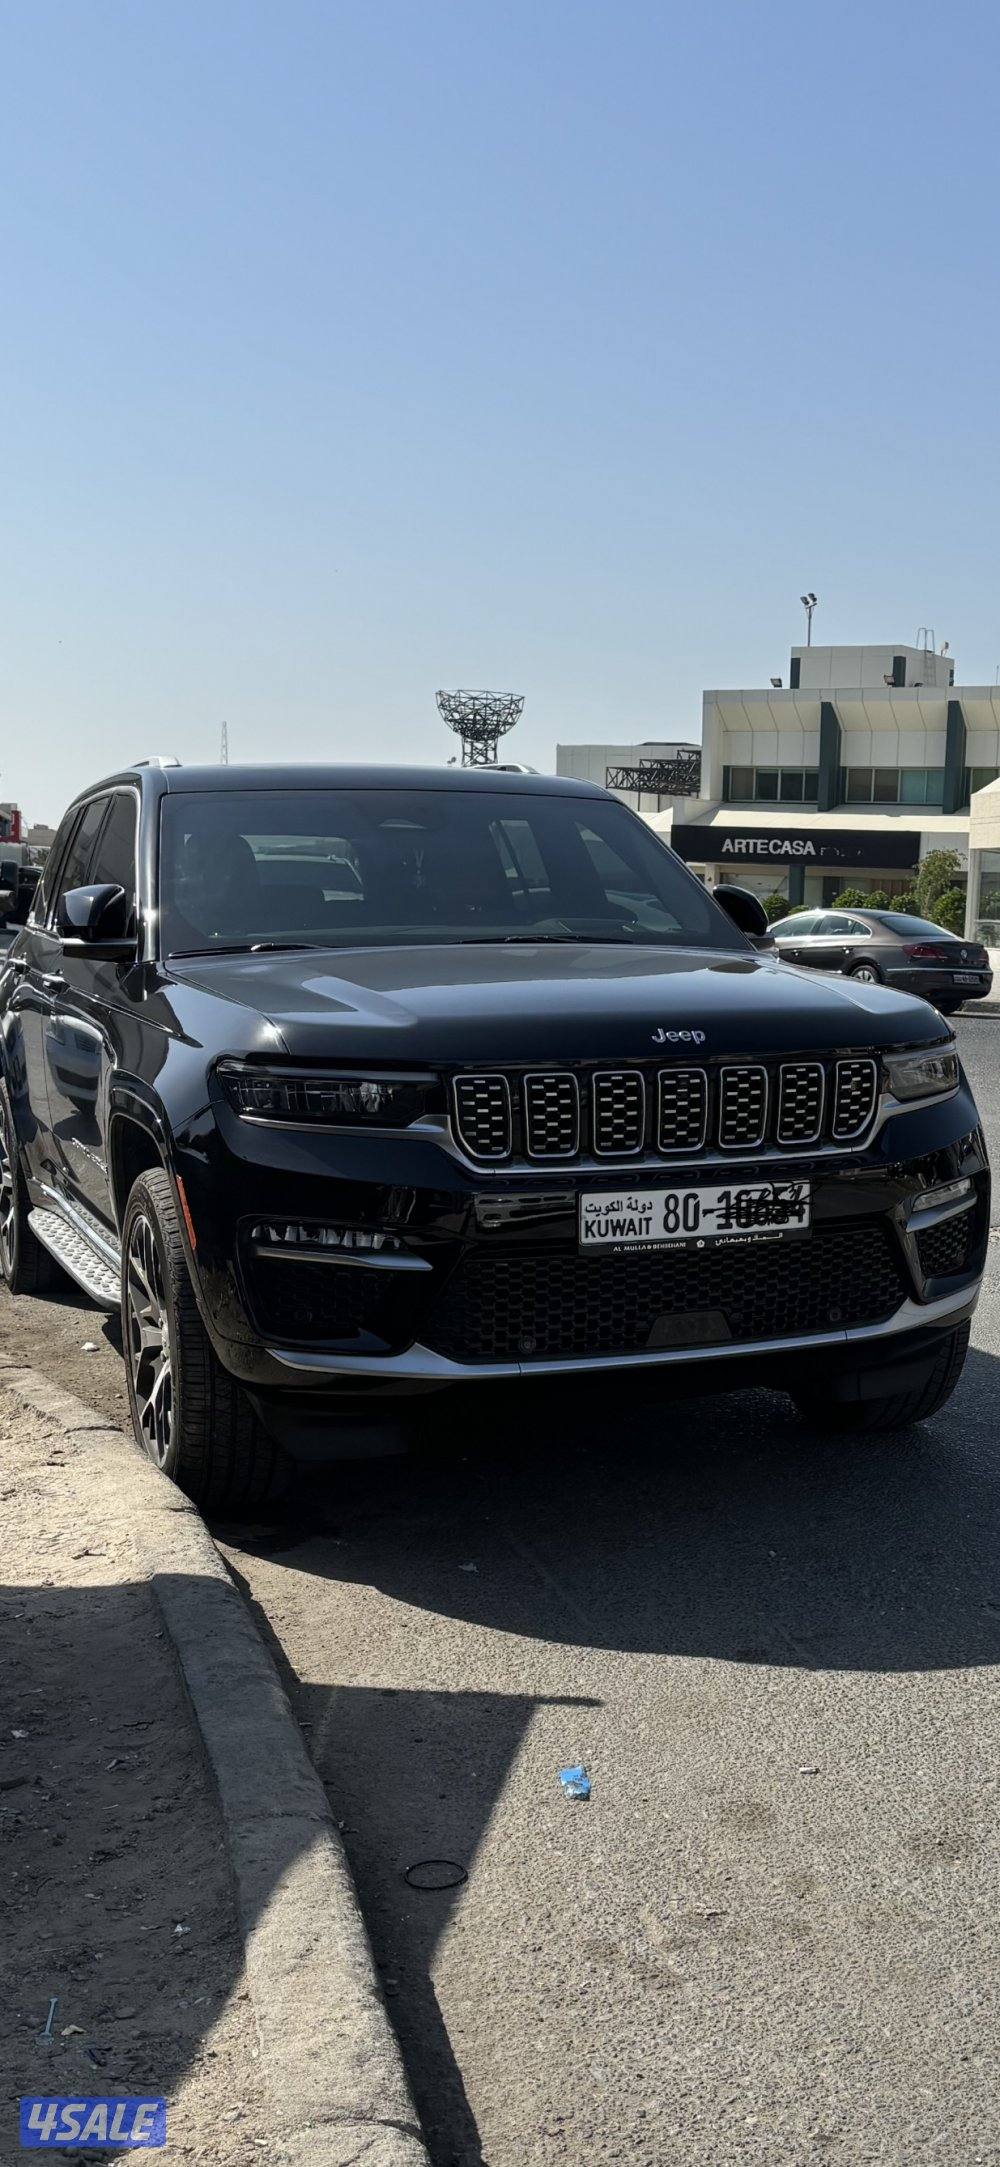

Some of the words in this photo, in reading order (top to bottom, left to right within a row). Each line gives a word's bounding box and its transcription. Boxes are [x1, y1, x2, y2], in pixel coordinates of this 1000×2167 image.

[721, 838, 816, 856] ARTECASA
[651, 1028, 706, 1045] Jeep
[585, 1200, 623, 1217] الكويت
[626, 1196, 653, 1214] دولة
[584, 1217, 653, 1239] KUWAIT
